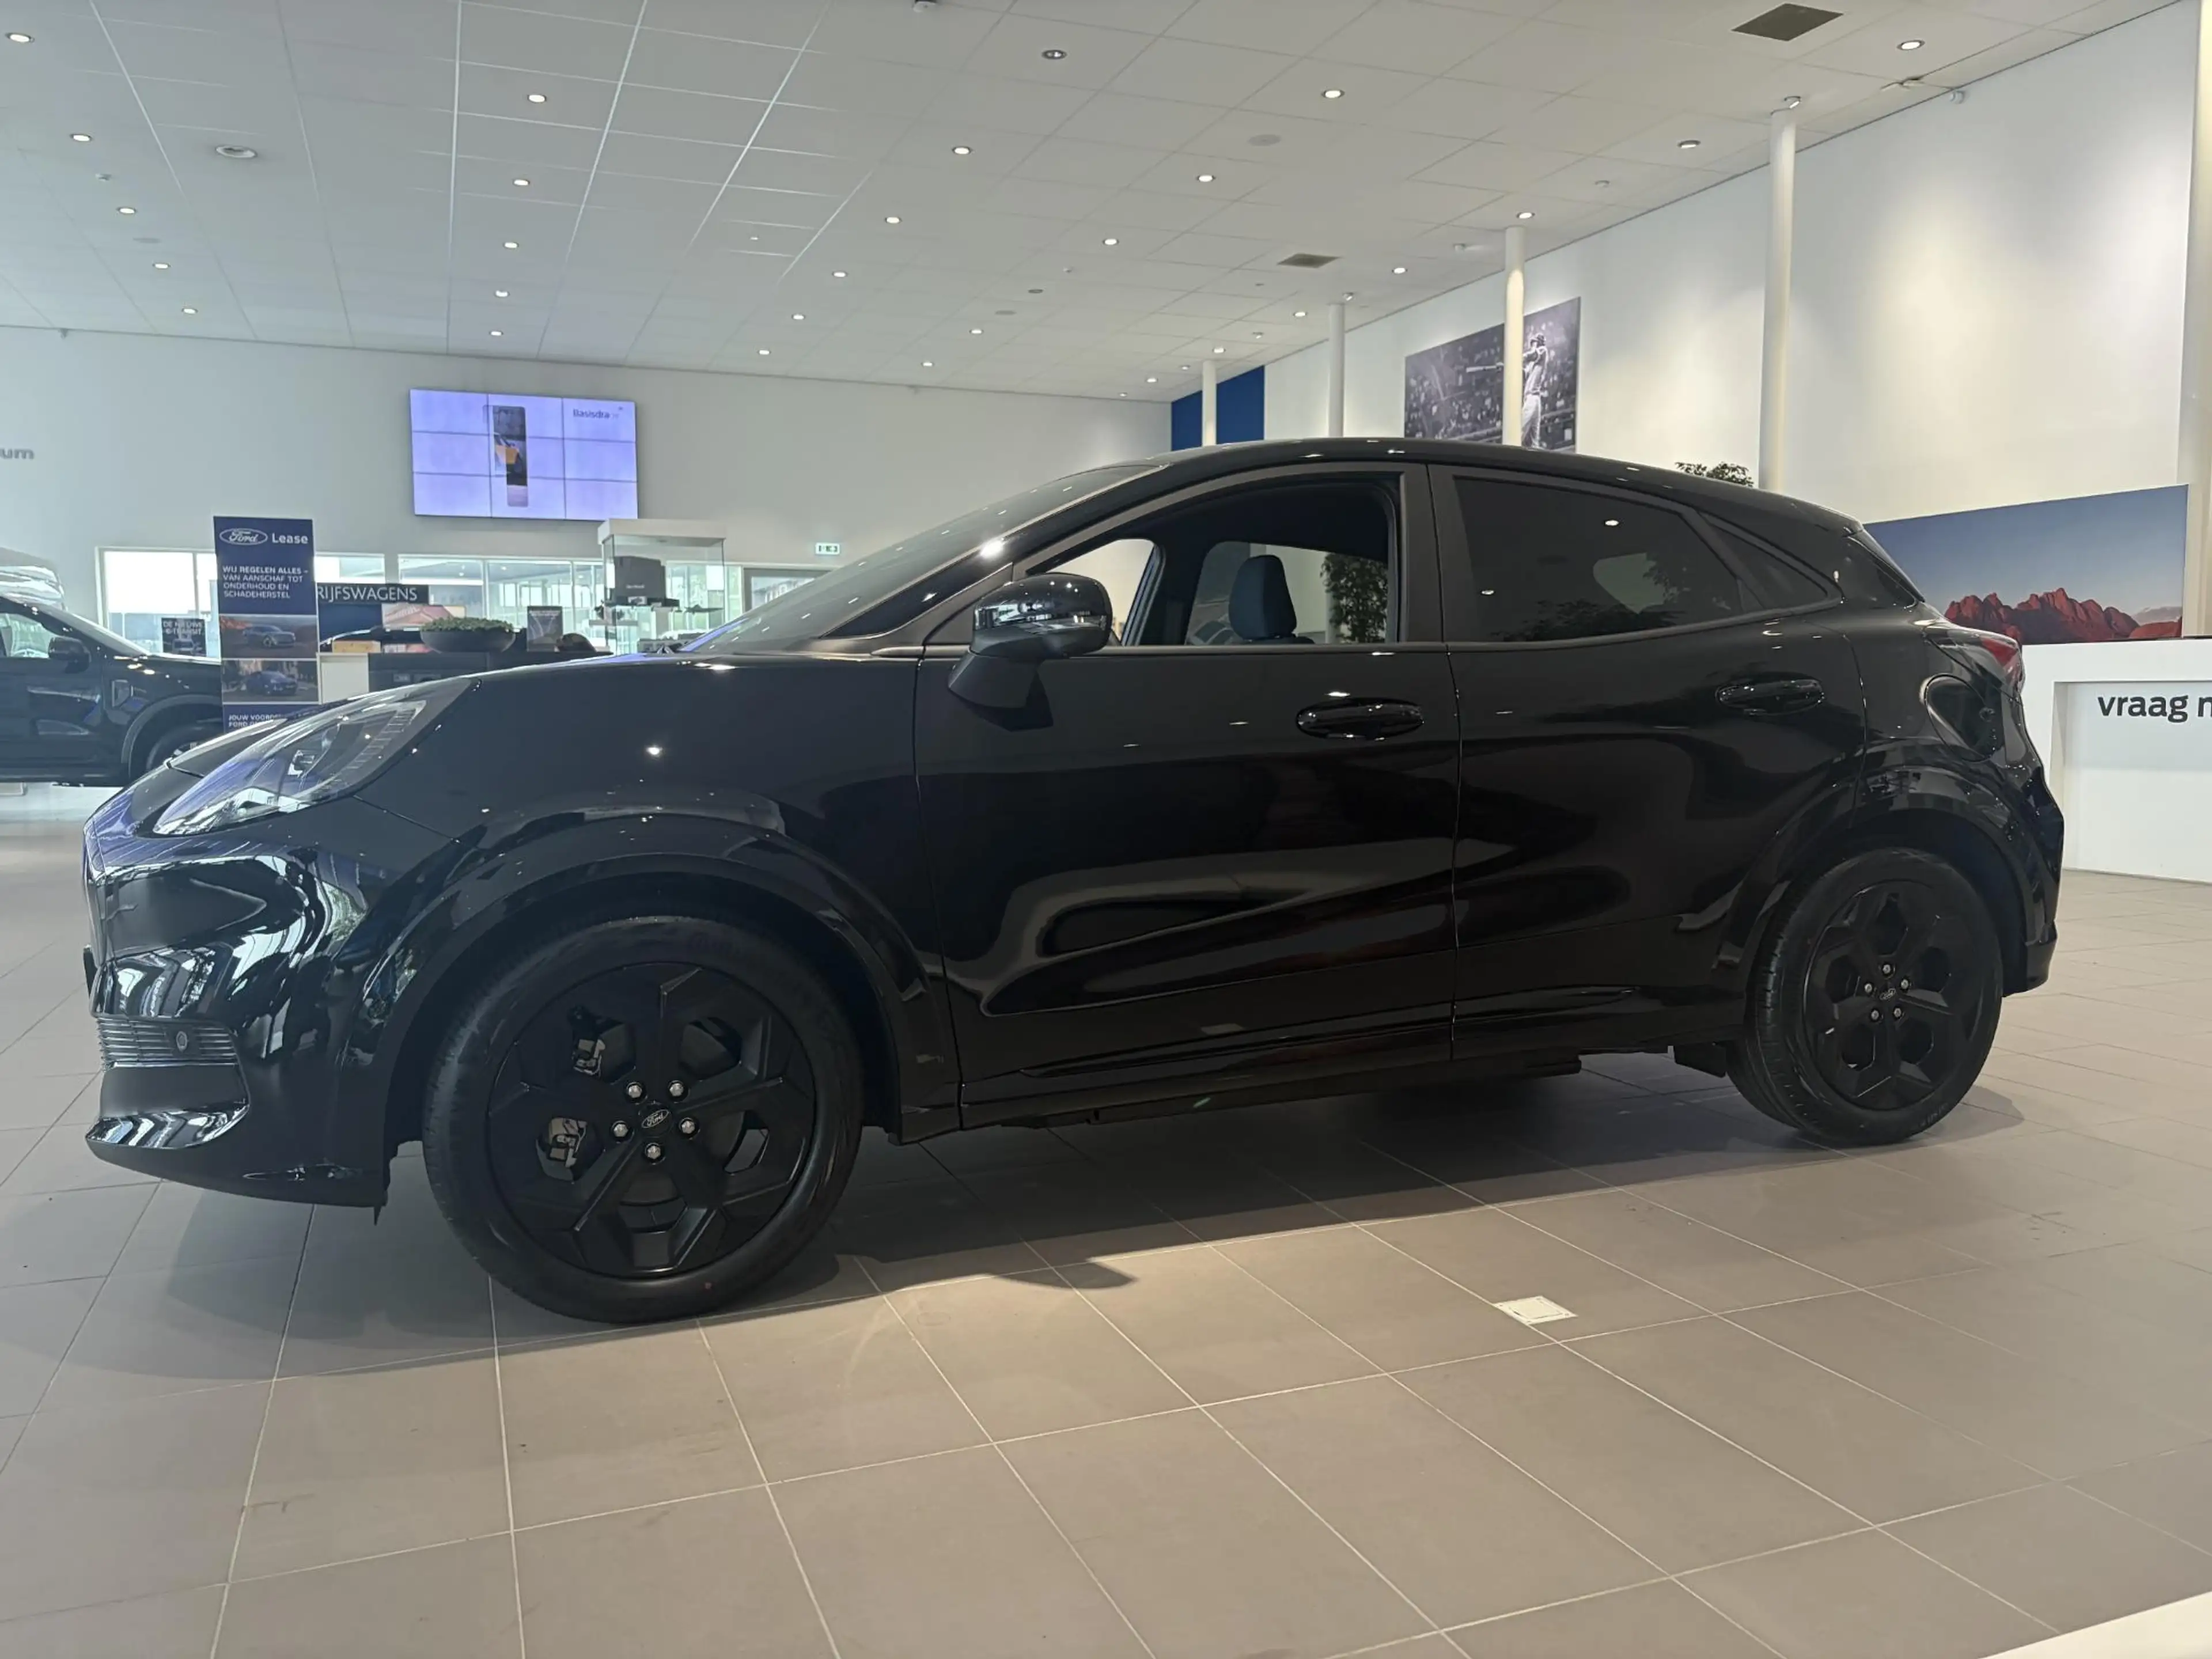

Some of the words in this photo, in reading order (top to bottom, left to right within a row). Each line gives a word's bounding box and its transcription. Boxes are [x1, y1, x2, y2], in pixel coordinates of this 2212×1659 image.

[227, 528, 260, 543] Ford
[272, 532, 309, 544] Lease
[240, 566, 275, 574] REGELEN
[278, 567, 302, 575] ALLES
[224, 590, 290, 599] SCHADEHERSTEL
[2097, 695, 2188, 724] vraag
[645, 1112, 665, 1127] Ford
